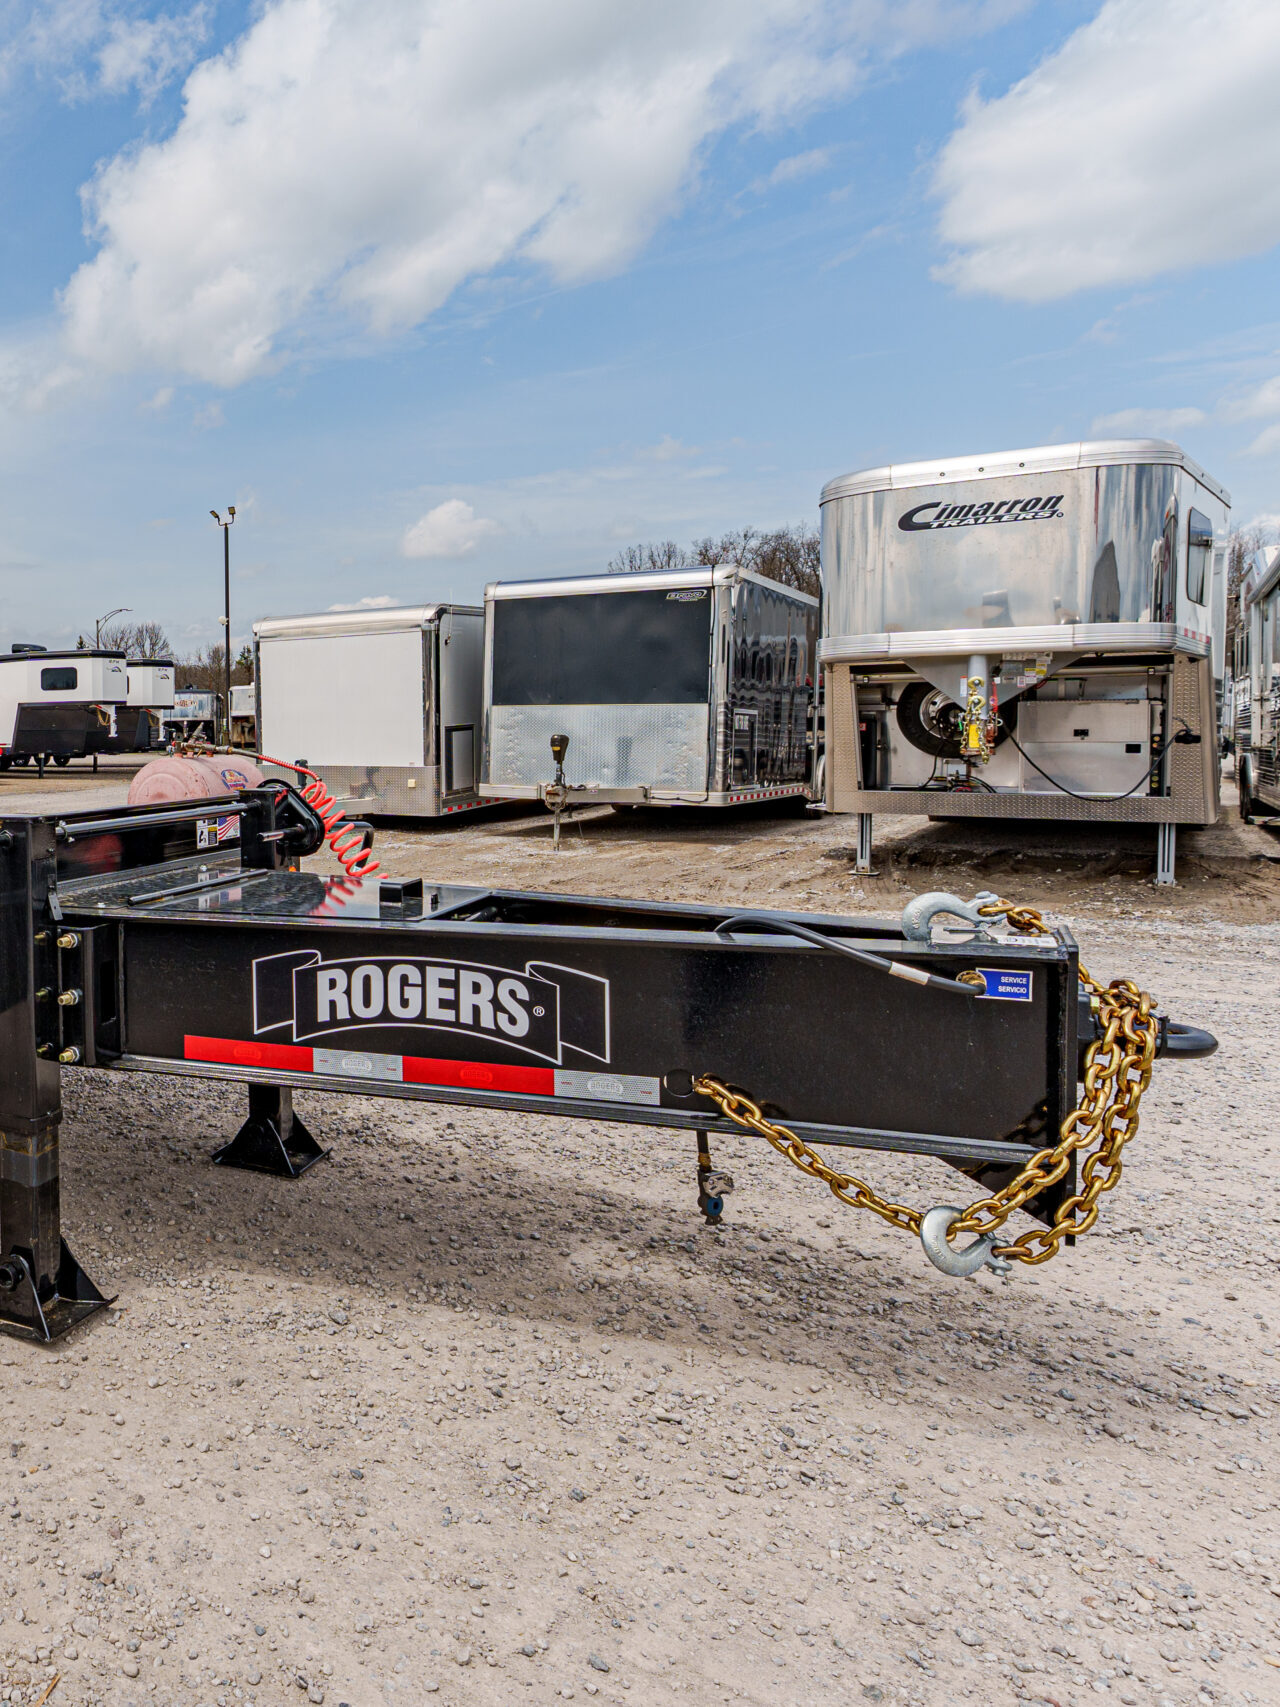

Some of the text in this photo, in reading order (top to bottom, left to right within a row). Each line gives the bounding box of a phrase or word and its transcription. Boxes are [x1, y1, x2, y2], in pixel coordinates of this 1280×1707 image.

[898, 495, 1064, 531] Cimarron
[930, 510, 1053, 529] TRAILERS
[1000, 976, 1027, 985] SERVICE
[998, 985, 1027, 994] SERVICIO
